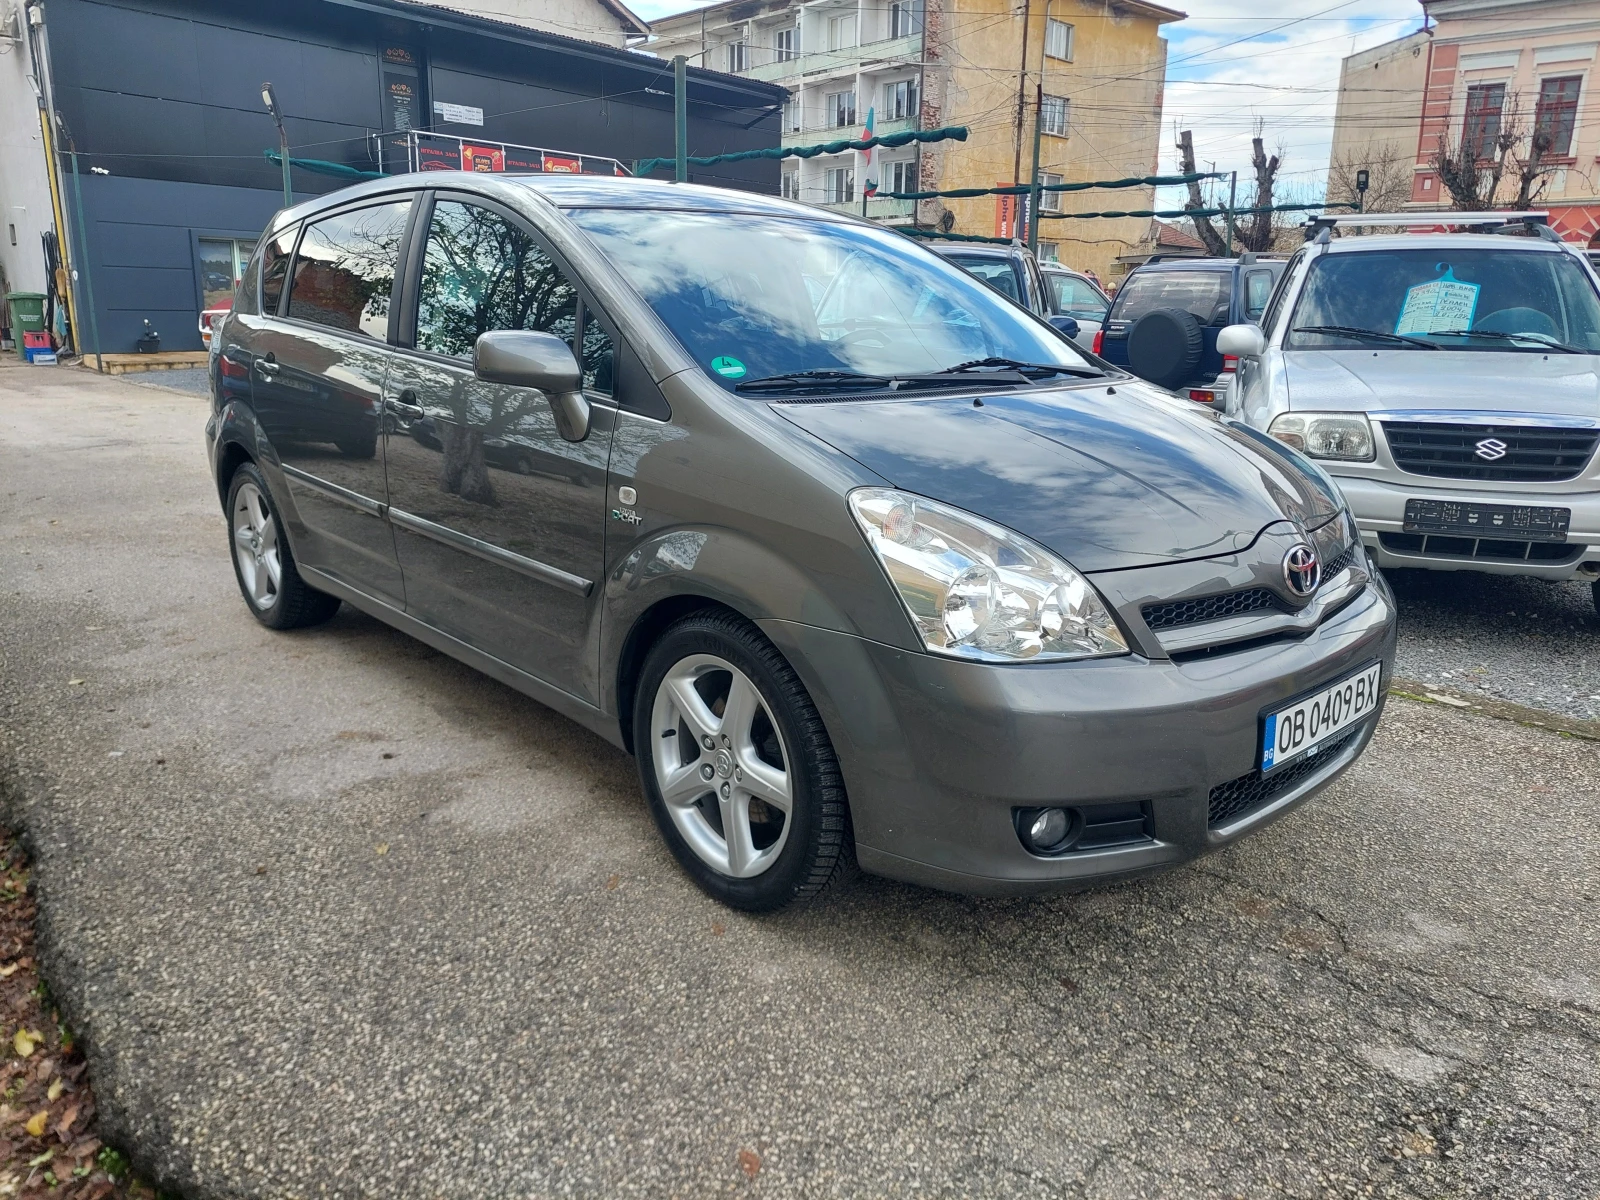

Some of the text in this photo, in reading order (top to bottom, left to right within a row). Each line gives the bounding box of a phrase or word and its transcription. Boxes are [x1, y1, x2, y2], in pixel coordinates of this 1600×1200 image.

[721, 357, 732, 367] 4
[1279, 709, 1305, 754] OB
[1310, 685, 1353, 739] 0409
[1354, 670, 1377, 715] BX
[1264, 748, 1274, 762] BG
